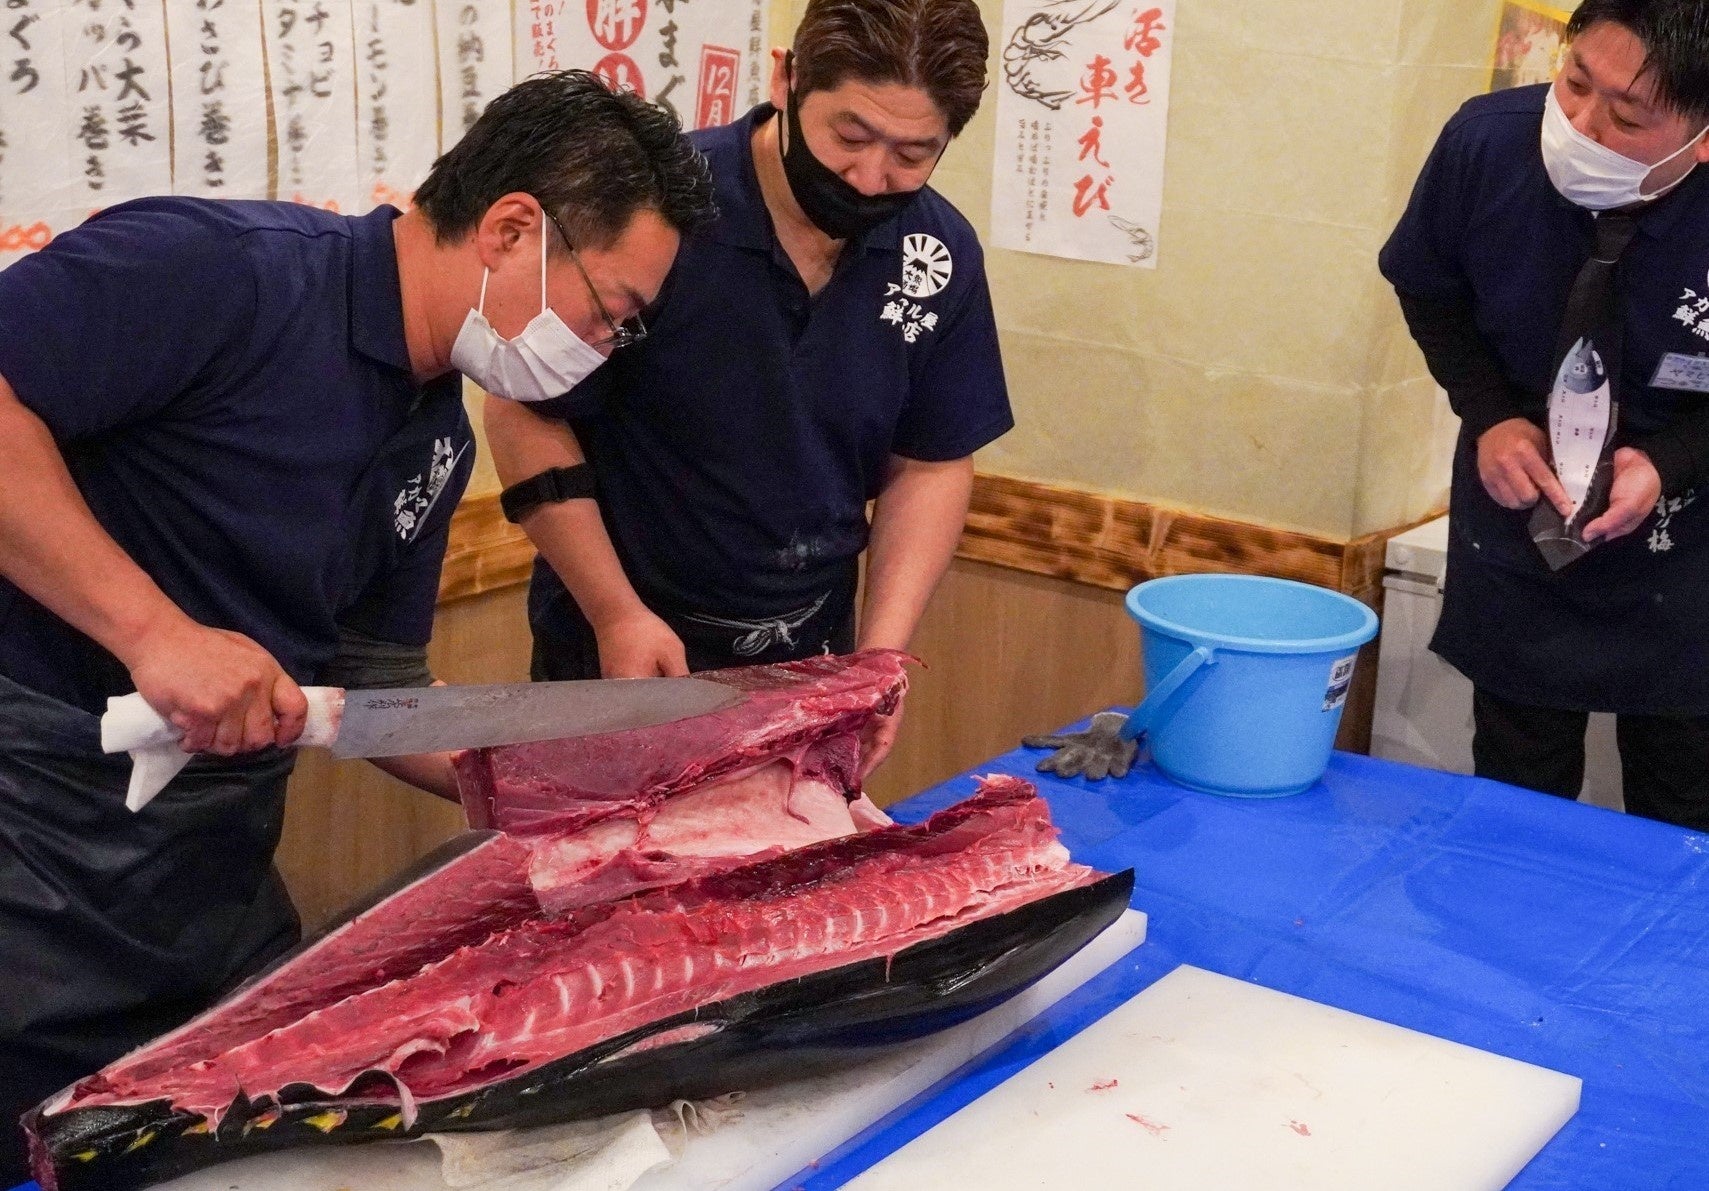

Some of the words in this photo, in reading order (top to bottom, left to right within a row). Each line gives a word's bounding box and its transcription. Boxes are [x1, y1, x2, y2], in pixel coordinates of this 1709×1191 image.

[76, 0, 110, 191] ッパ巻き
[1072, 54, 1120, 218] 車えび
[1124, 8, 1166, 105] 活き
